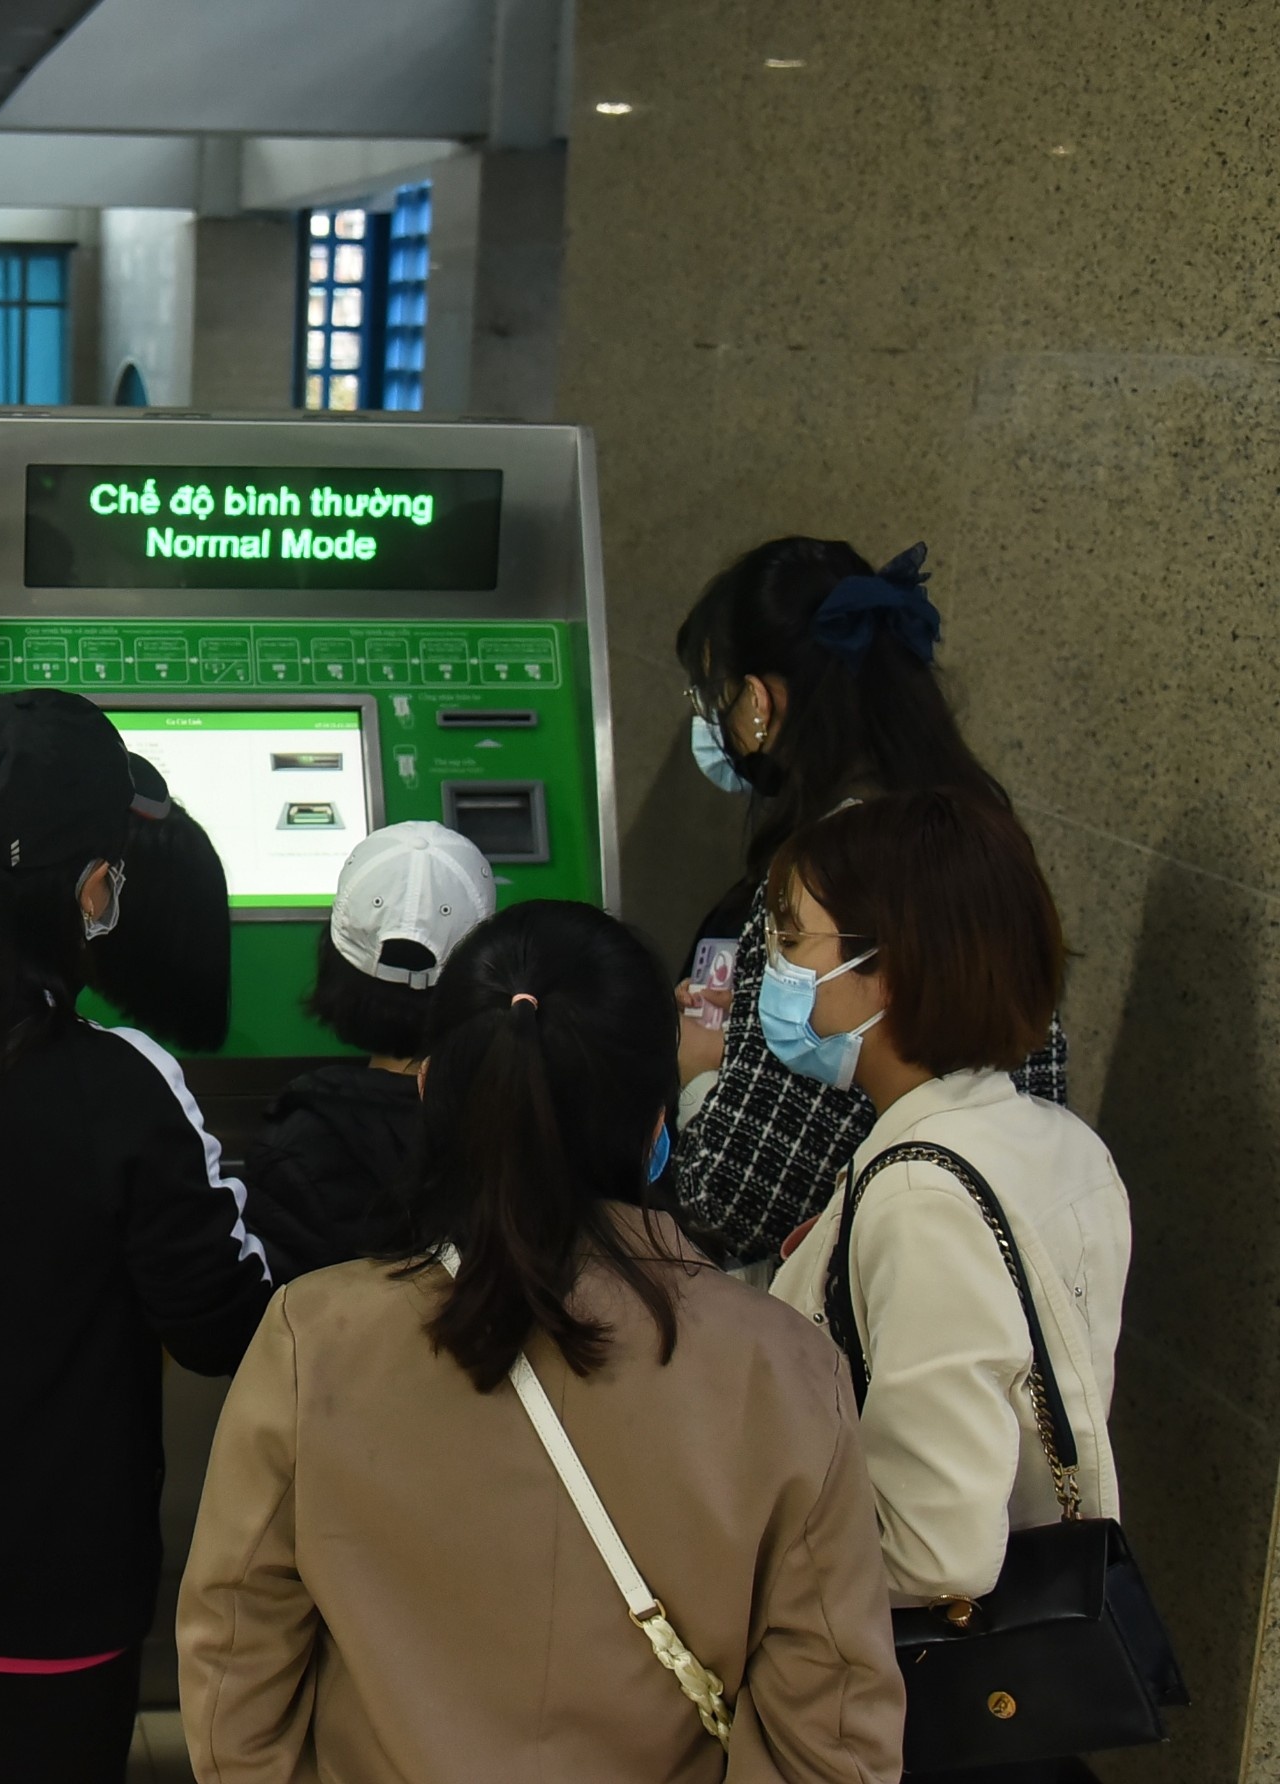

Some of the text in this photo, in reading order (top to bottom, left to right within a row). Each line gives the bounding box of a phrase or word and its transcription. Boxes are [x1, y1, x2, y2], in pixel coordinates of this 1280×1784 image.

[90, 478, 433, 525] Chế độ bình thường
[145, 527, 376, 560] Normal Mode
